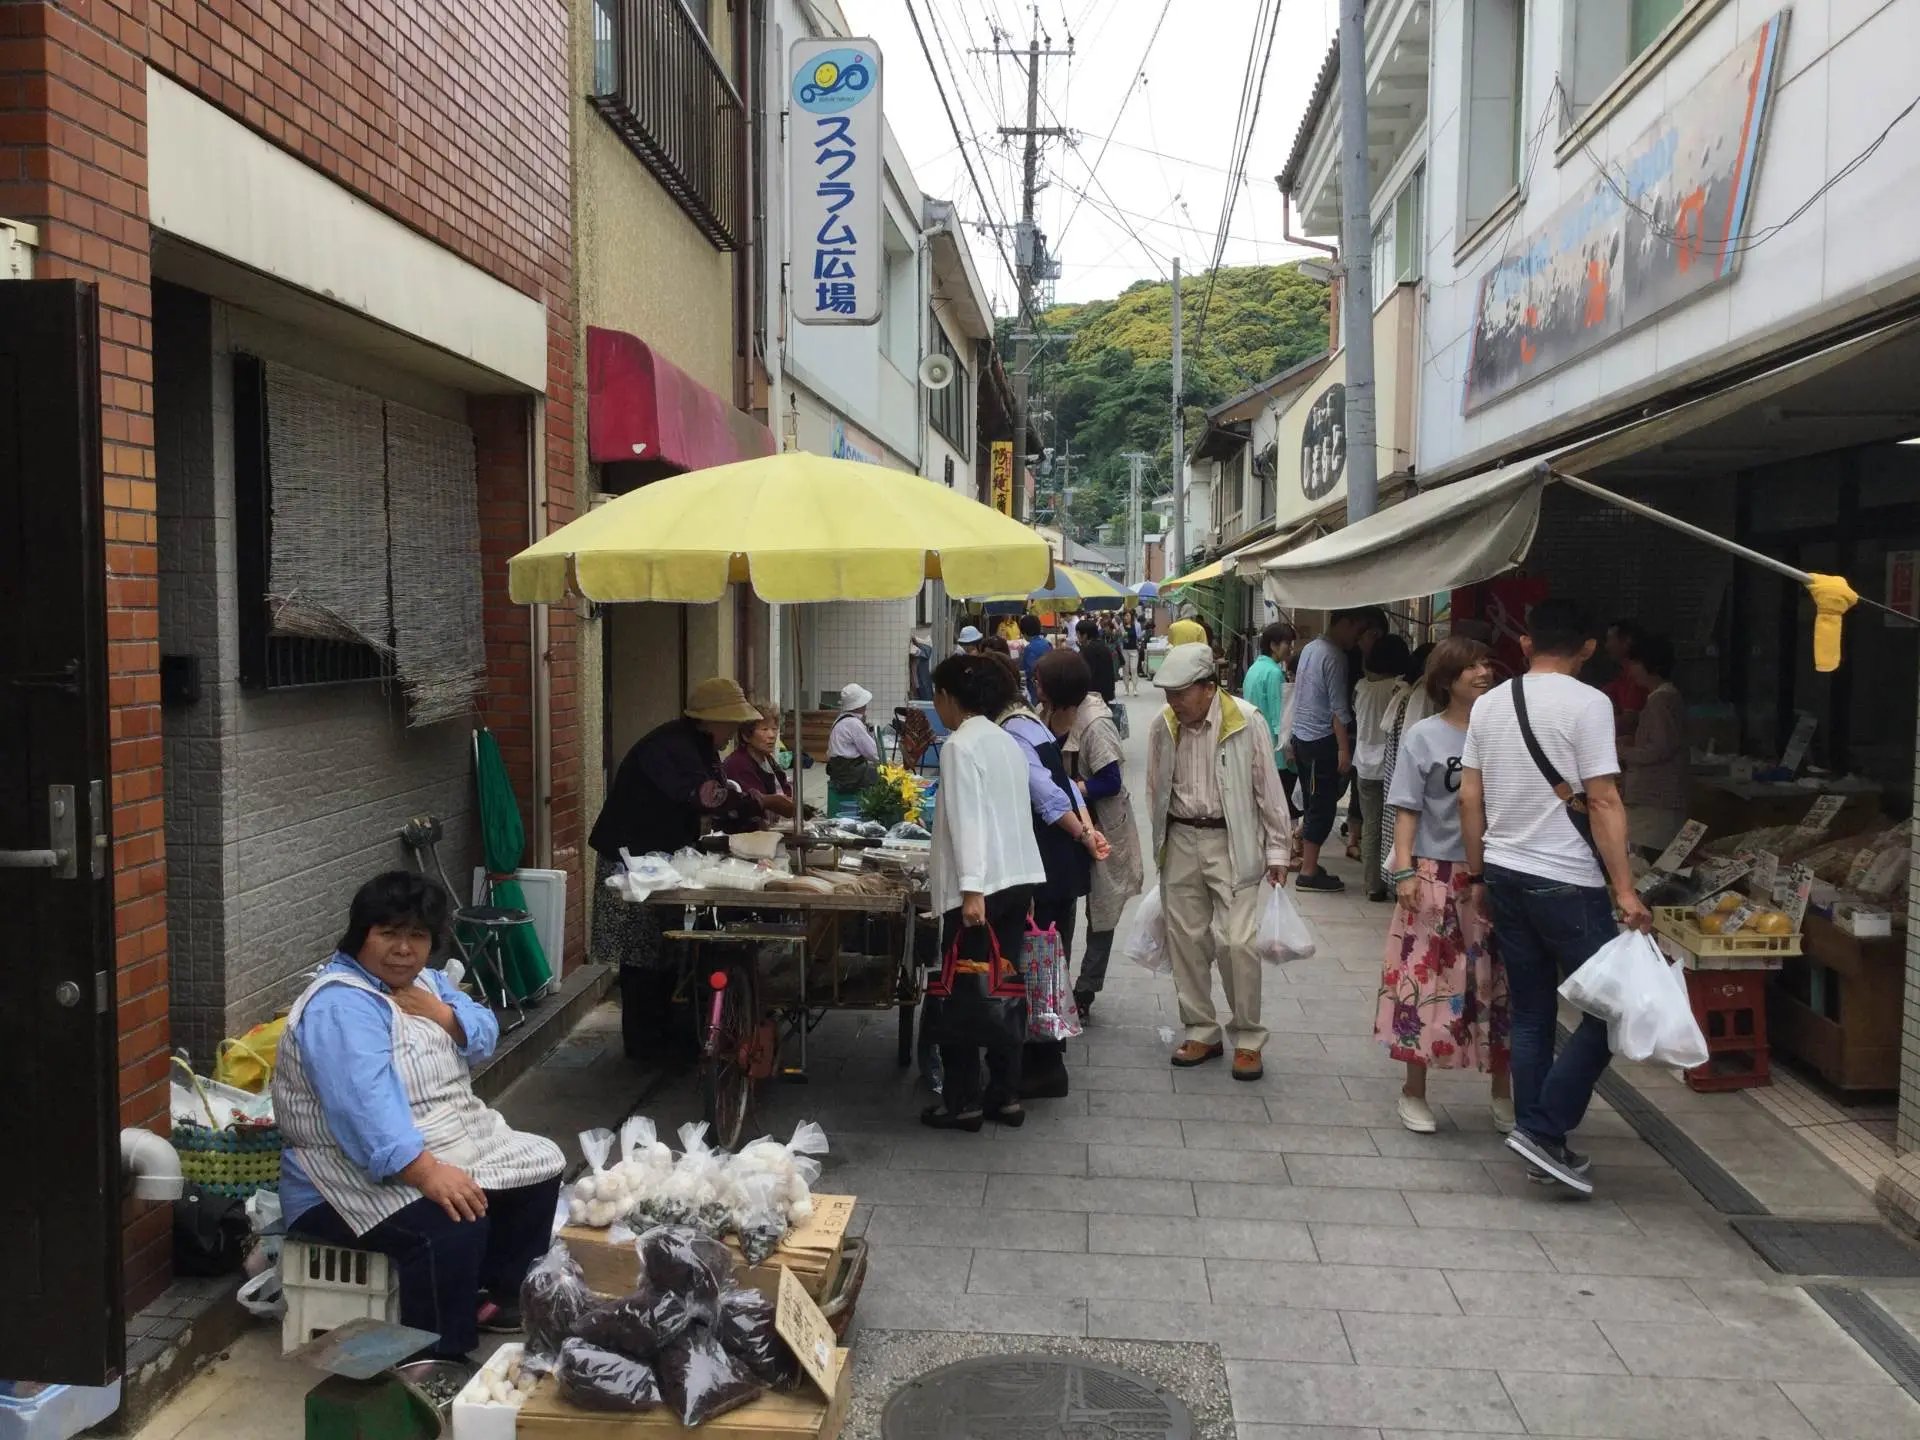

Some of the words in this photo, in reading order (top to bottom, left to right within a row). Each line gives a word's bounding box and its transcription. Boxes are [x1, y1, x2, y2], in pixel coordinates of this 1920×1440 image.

[814, 117, 857, 314] スクラム広場
